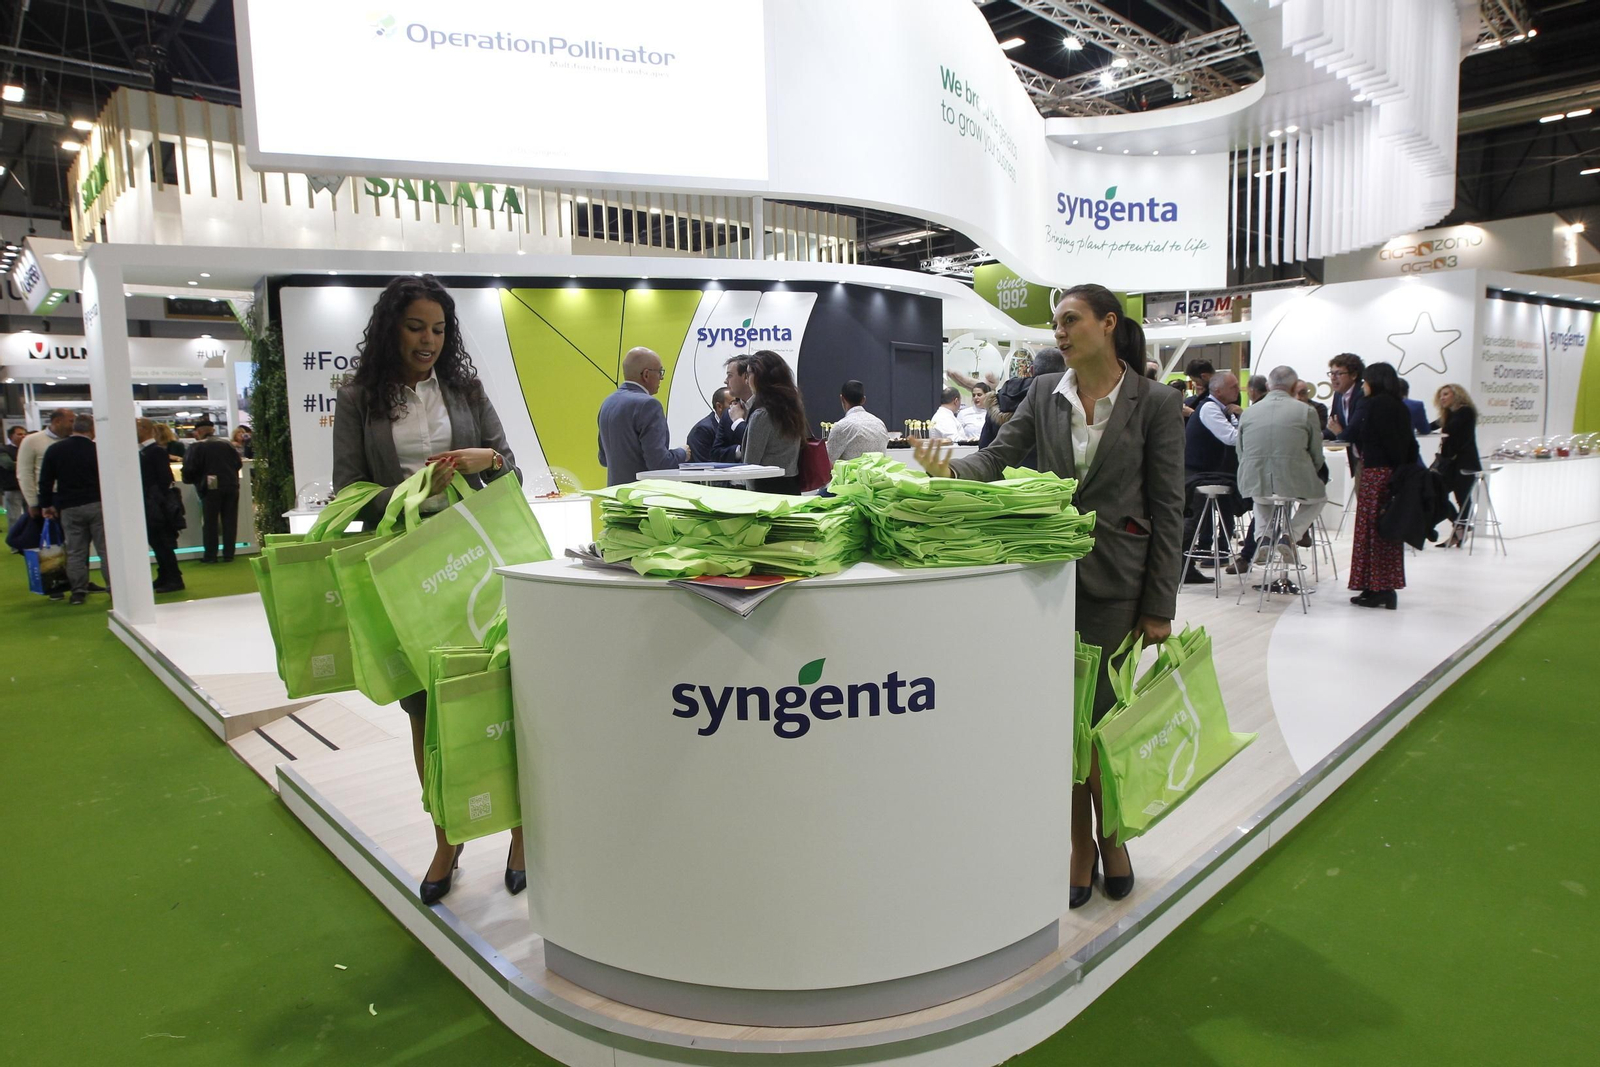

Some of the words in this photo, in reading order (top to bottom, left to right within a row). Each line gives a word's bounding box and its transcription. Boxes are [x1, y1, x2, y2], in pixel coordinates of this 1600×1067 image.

[405, 22, 676, 67] OperationPollinator
[940, 64, 963, 98] We
[940, 98, 956, 126] to
[958, 112, 983, 143] grow
[1056, 191, 1178, 231] syngenta
[1044, 224, 1075, 254] Bringing
[1076, 234, 1108, 257] plant
[1107, 239, 1170, 260] potential
[1168, 241, 1182, 253] to
[1182, 237, 1211, 258] life
[996, 287, 1029, 310] 1992
[696, 324, 793, 348] syngenta
[1492, 364, 1544, 380] #Conveniencia
[421, 544, 486, 595] syngenta
[671, 670, 937, 740] syngenta
[1138, 708, 1189, 760] syngenta
